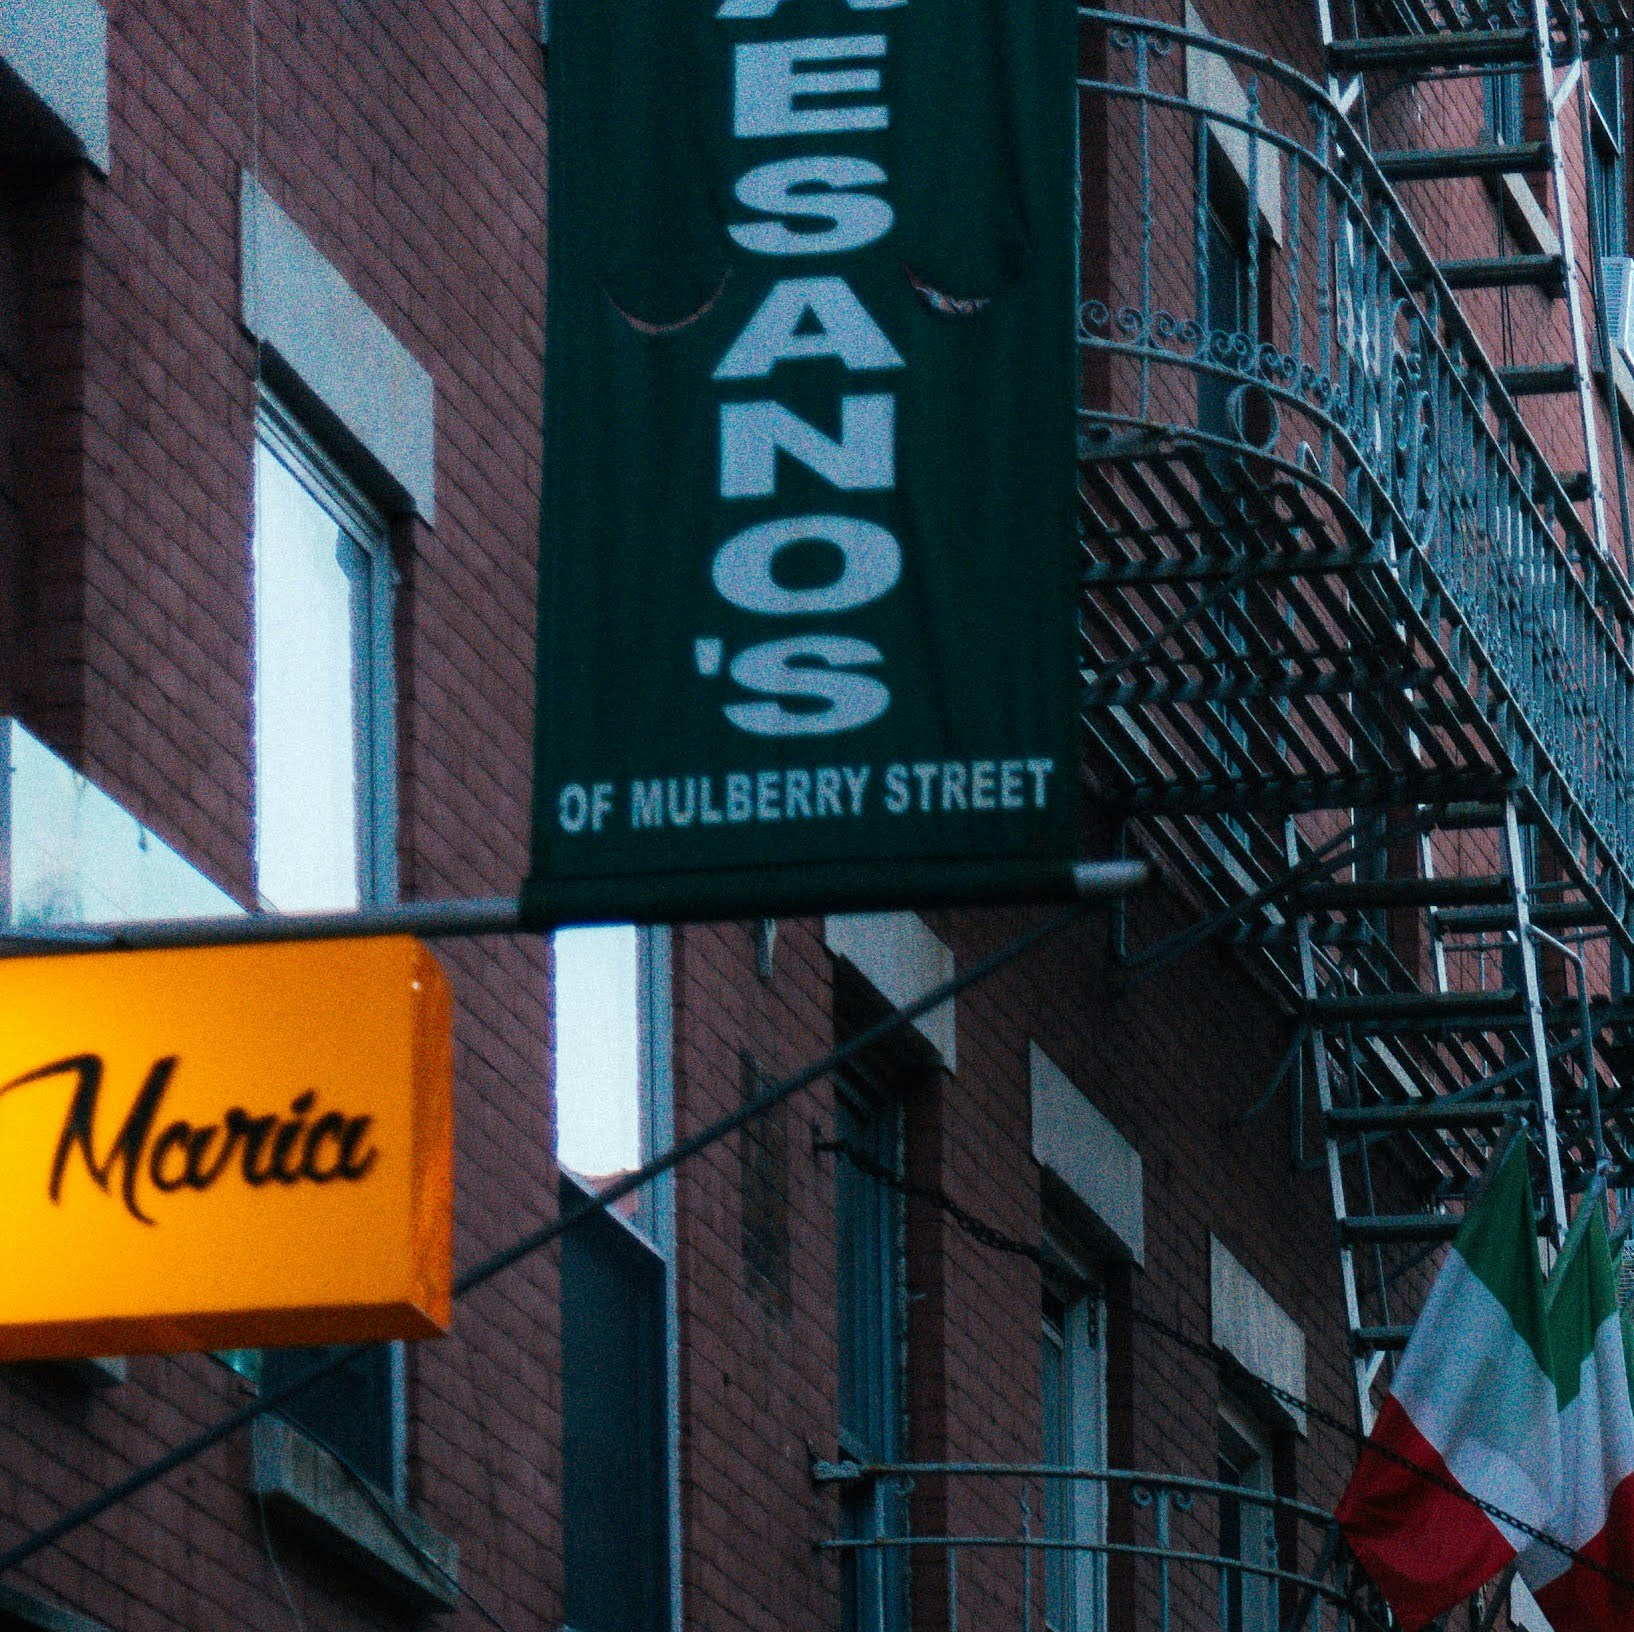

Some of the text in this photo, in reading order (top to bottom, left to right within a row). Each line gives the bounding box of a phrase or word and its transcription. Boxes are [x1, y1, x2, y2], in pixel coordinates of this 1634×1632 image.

[695, 0, 908, 737] ESANO'S
[558, 757, 1053, 834] OF MULBERRY STREET
[0, 1053, 379, 1227] Maria
